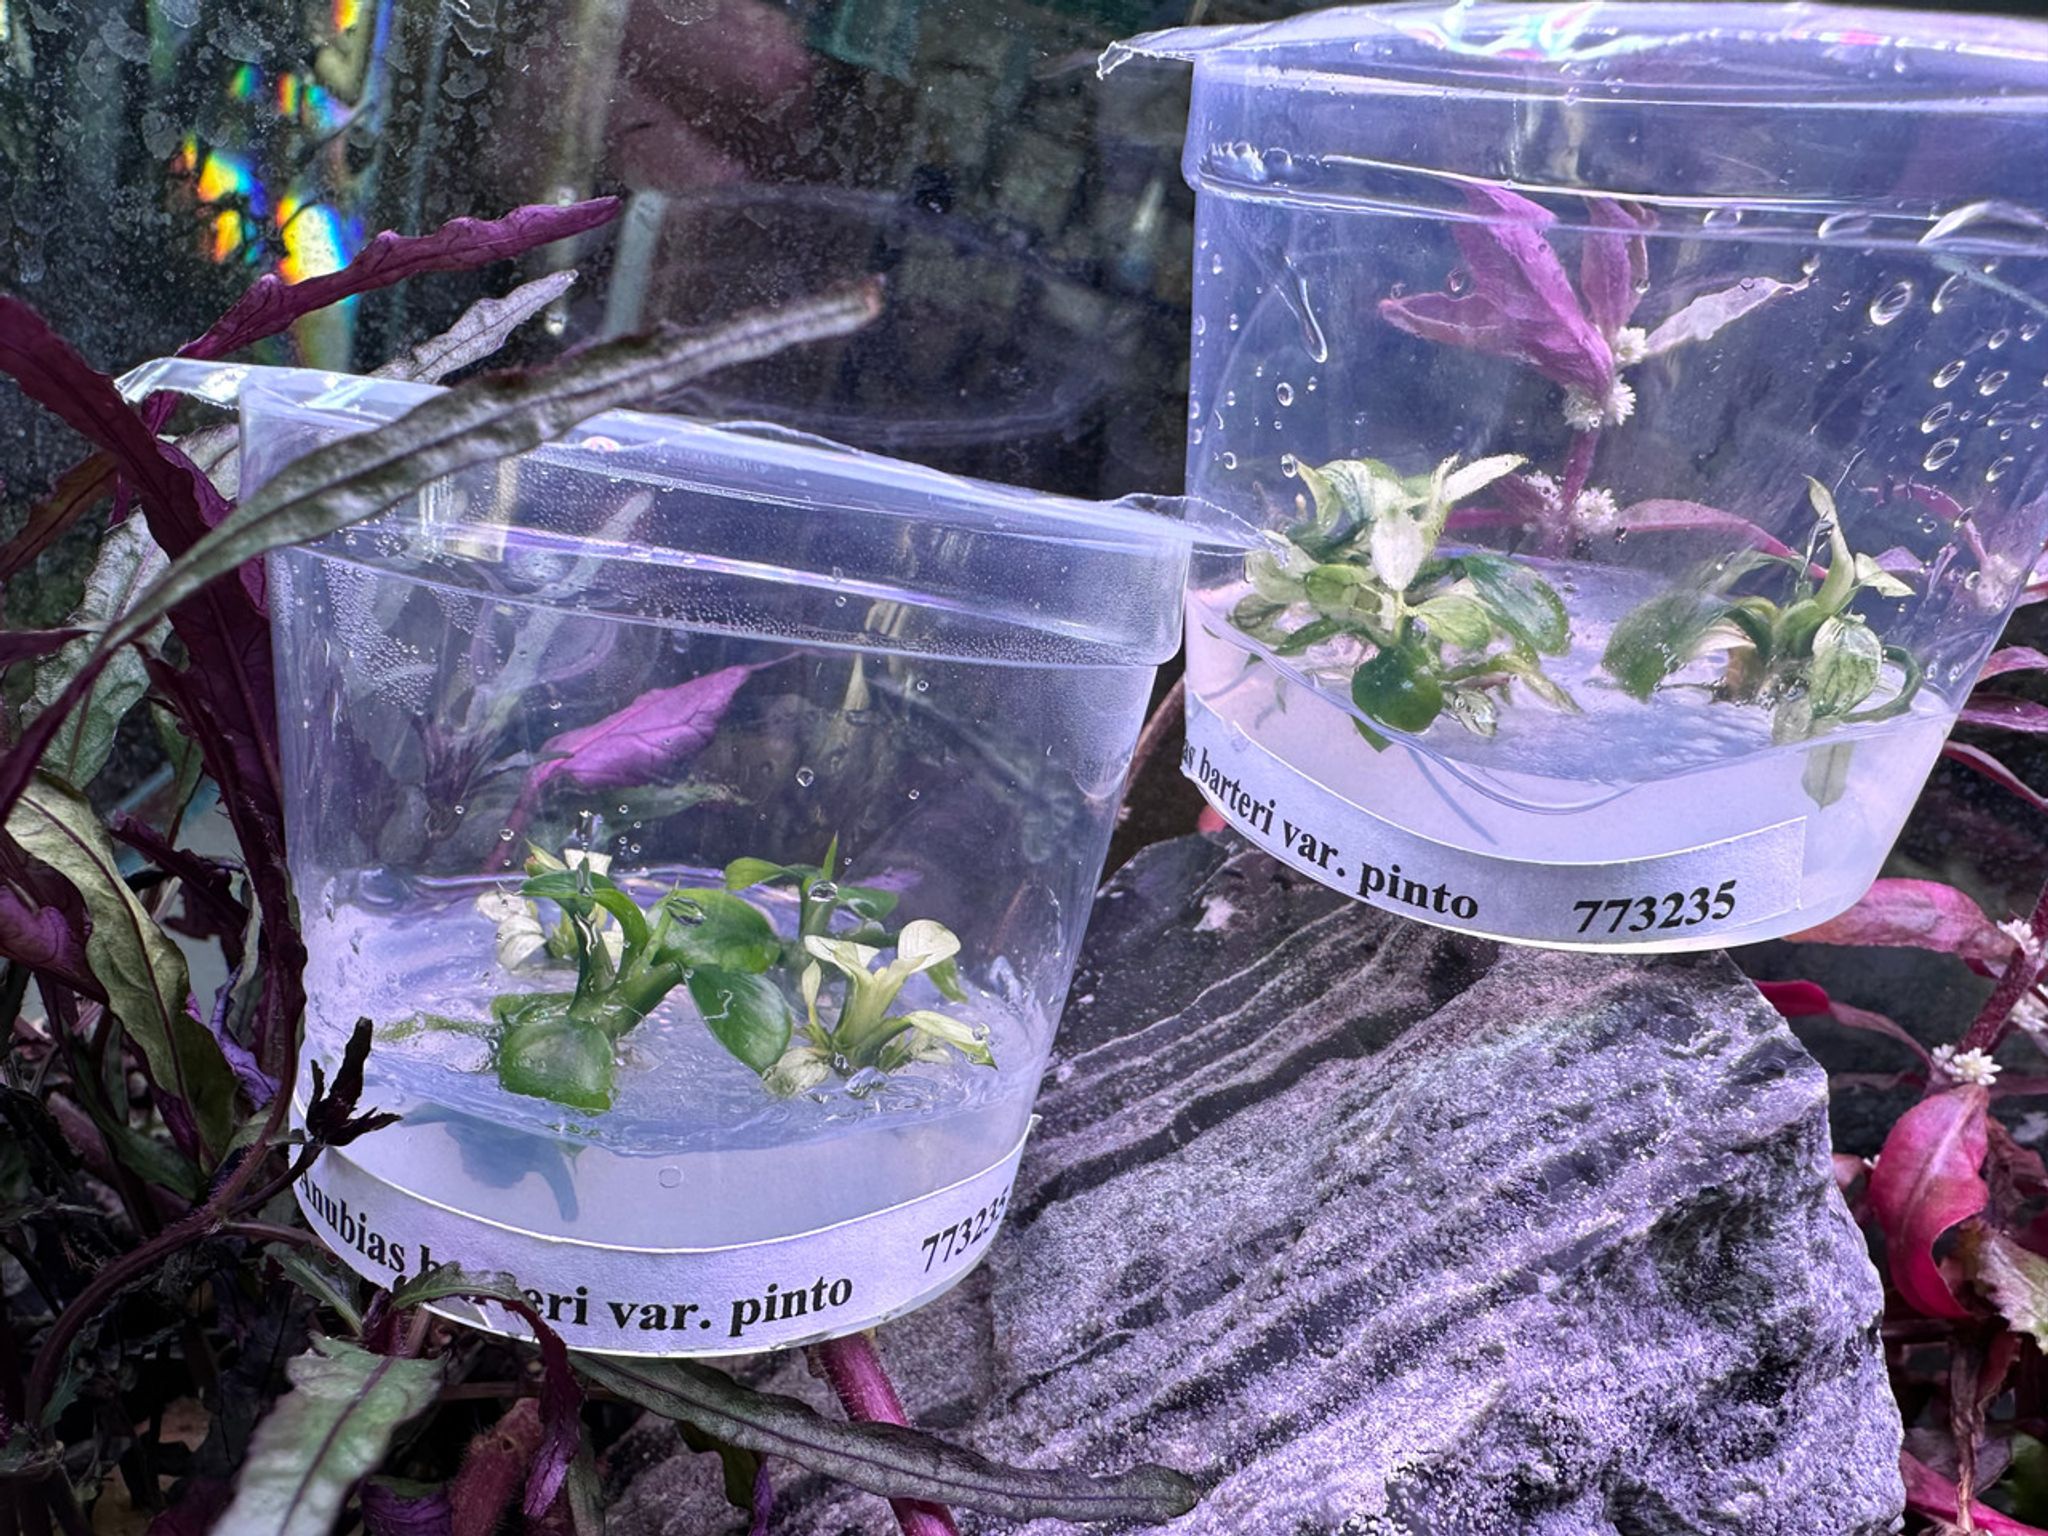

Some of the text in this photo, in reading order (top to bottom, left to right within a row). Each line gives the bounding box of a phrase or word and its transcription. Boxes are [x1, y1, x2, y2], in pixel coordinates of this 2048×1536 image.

[1199, 747, 1276, 836] barteri
[1282, 819, 1346, 878] var.
[1356, 862, 1479, 920] pinto
[1573, 880, 1737, 933] 773235
[299, 1169, 405, 1273] Anubias
[419, 1244, 588, 1326] beri
[608, 1301, 711, 1331] var.
[728, 1275, 853, 1337] pinto
